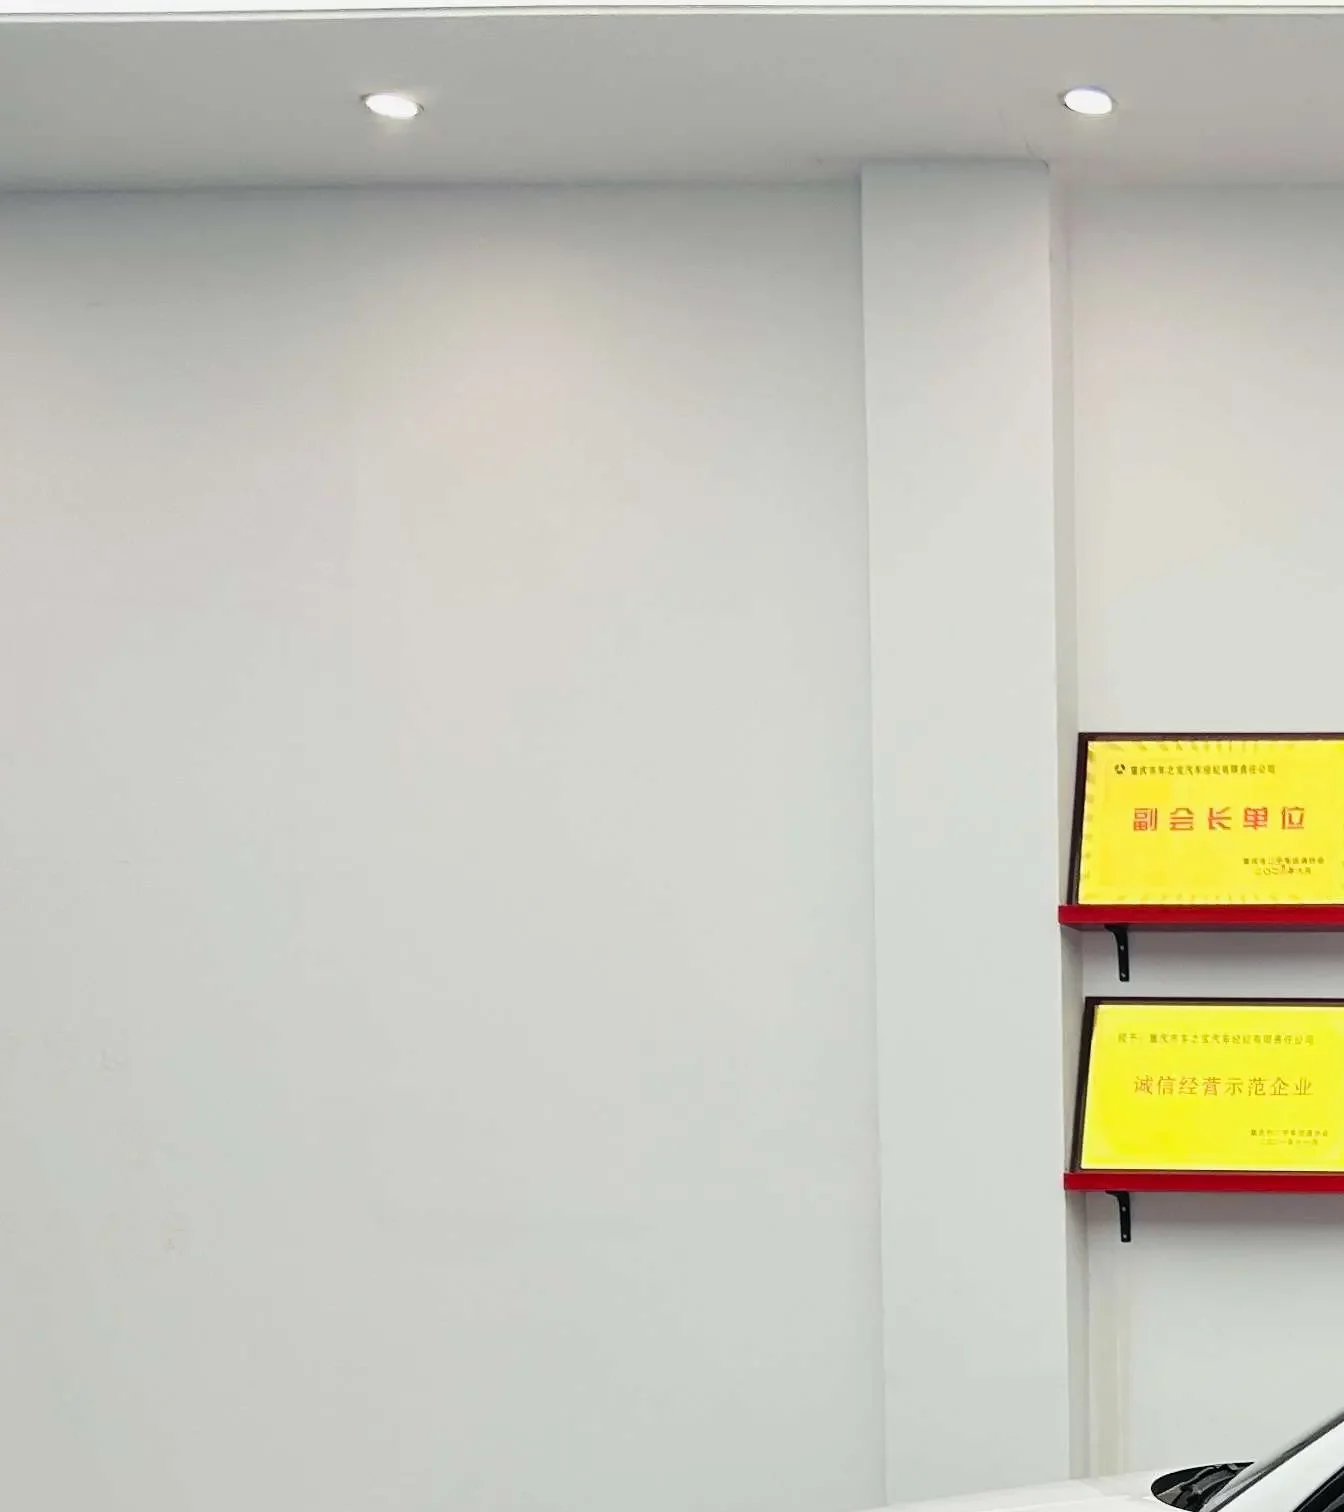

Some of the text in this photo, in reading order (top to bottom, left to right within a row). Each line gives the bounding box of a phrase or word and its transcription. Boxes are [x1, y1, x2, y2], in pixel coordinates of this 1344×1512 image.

[1132, 806, 1306, 832] 副会长单位
[1133, 1075, 1314, 1097] 诚信经营示范企业
